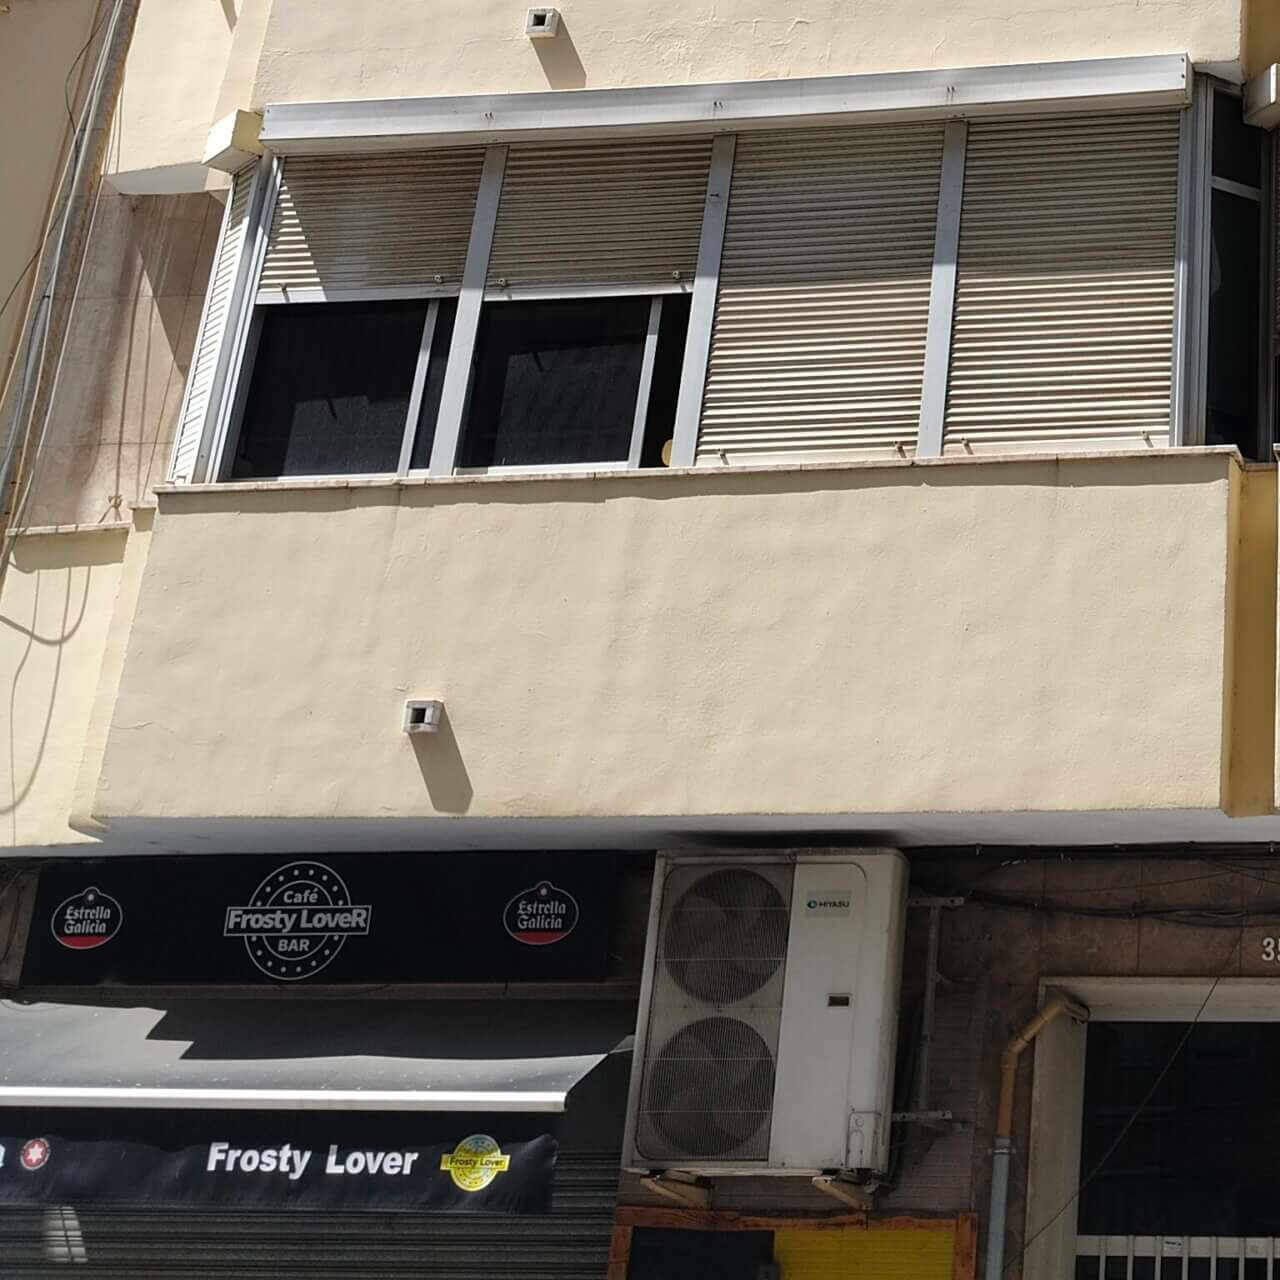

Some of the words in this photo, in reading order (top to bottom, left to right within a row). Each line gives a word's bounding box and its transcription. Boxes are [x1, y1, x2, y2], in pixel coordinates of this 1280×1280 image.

[283, 887, 318, 903] Café
[64, 905, 111, 920] Estrella
[518, 900, 566, 915] Estrella
[64, 920, 107, 934] Galicia
[228, 909, 298, 933] Frosty
[300, 908, 367, 928] LoveR
[518, 915, 563, 929] Galicia
[278, 939, 310, 952] BAR
[206, 1142, 312, 1180] Frosty
[326, 1144, 418, 1175] Lover
[449, 1157, 477, 1168] Frosty
